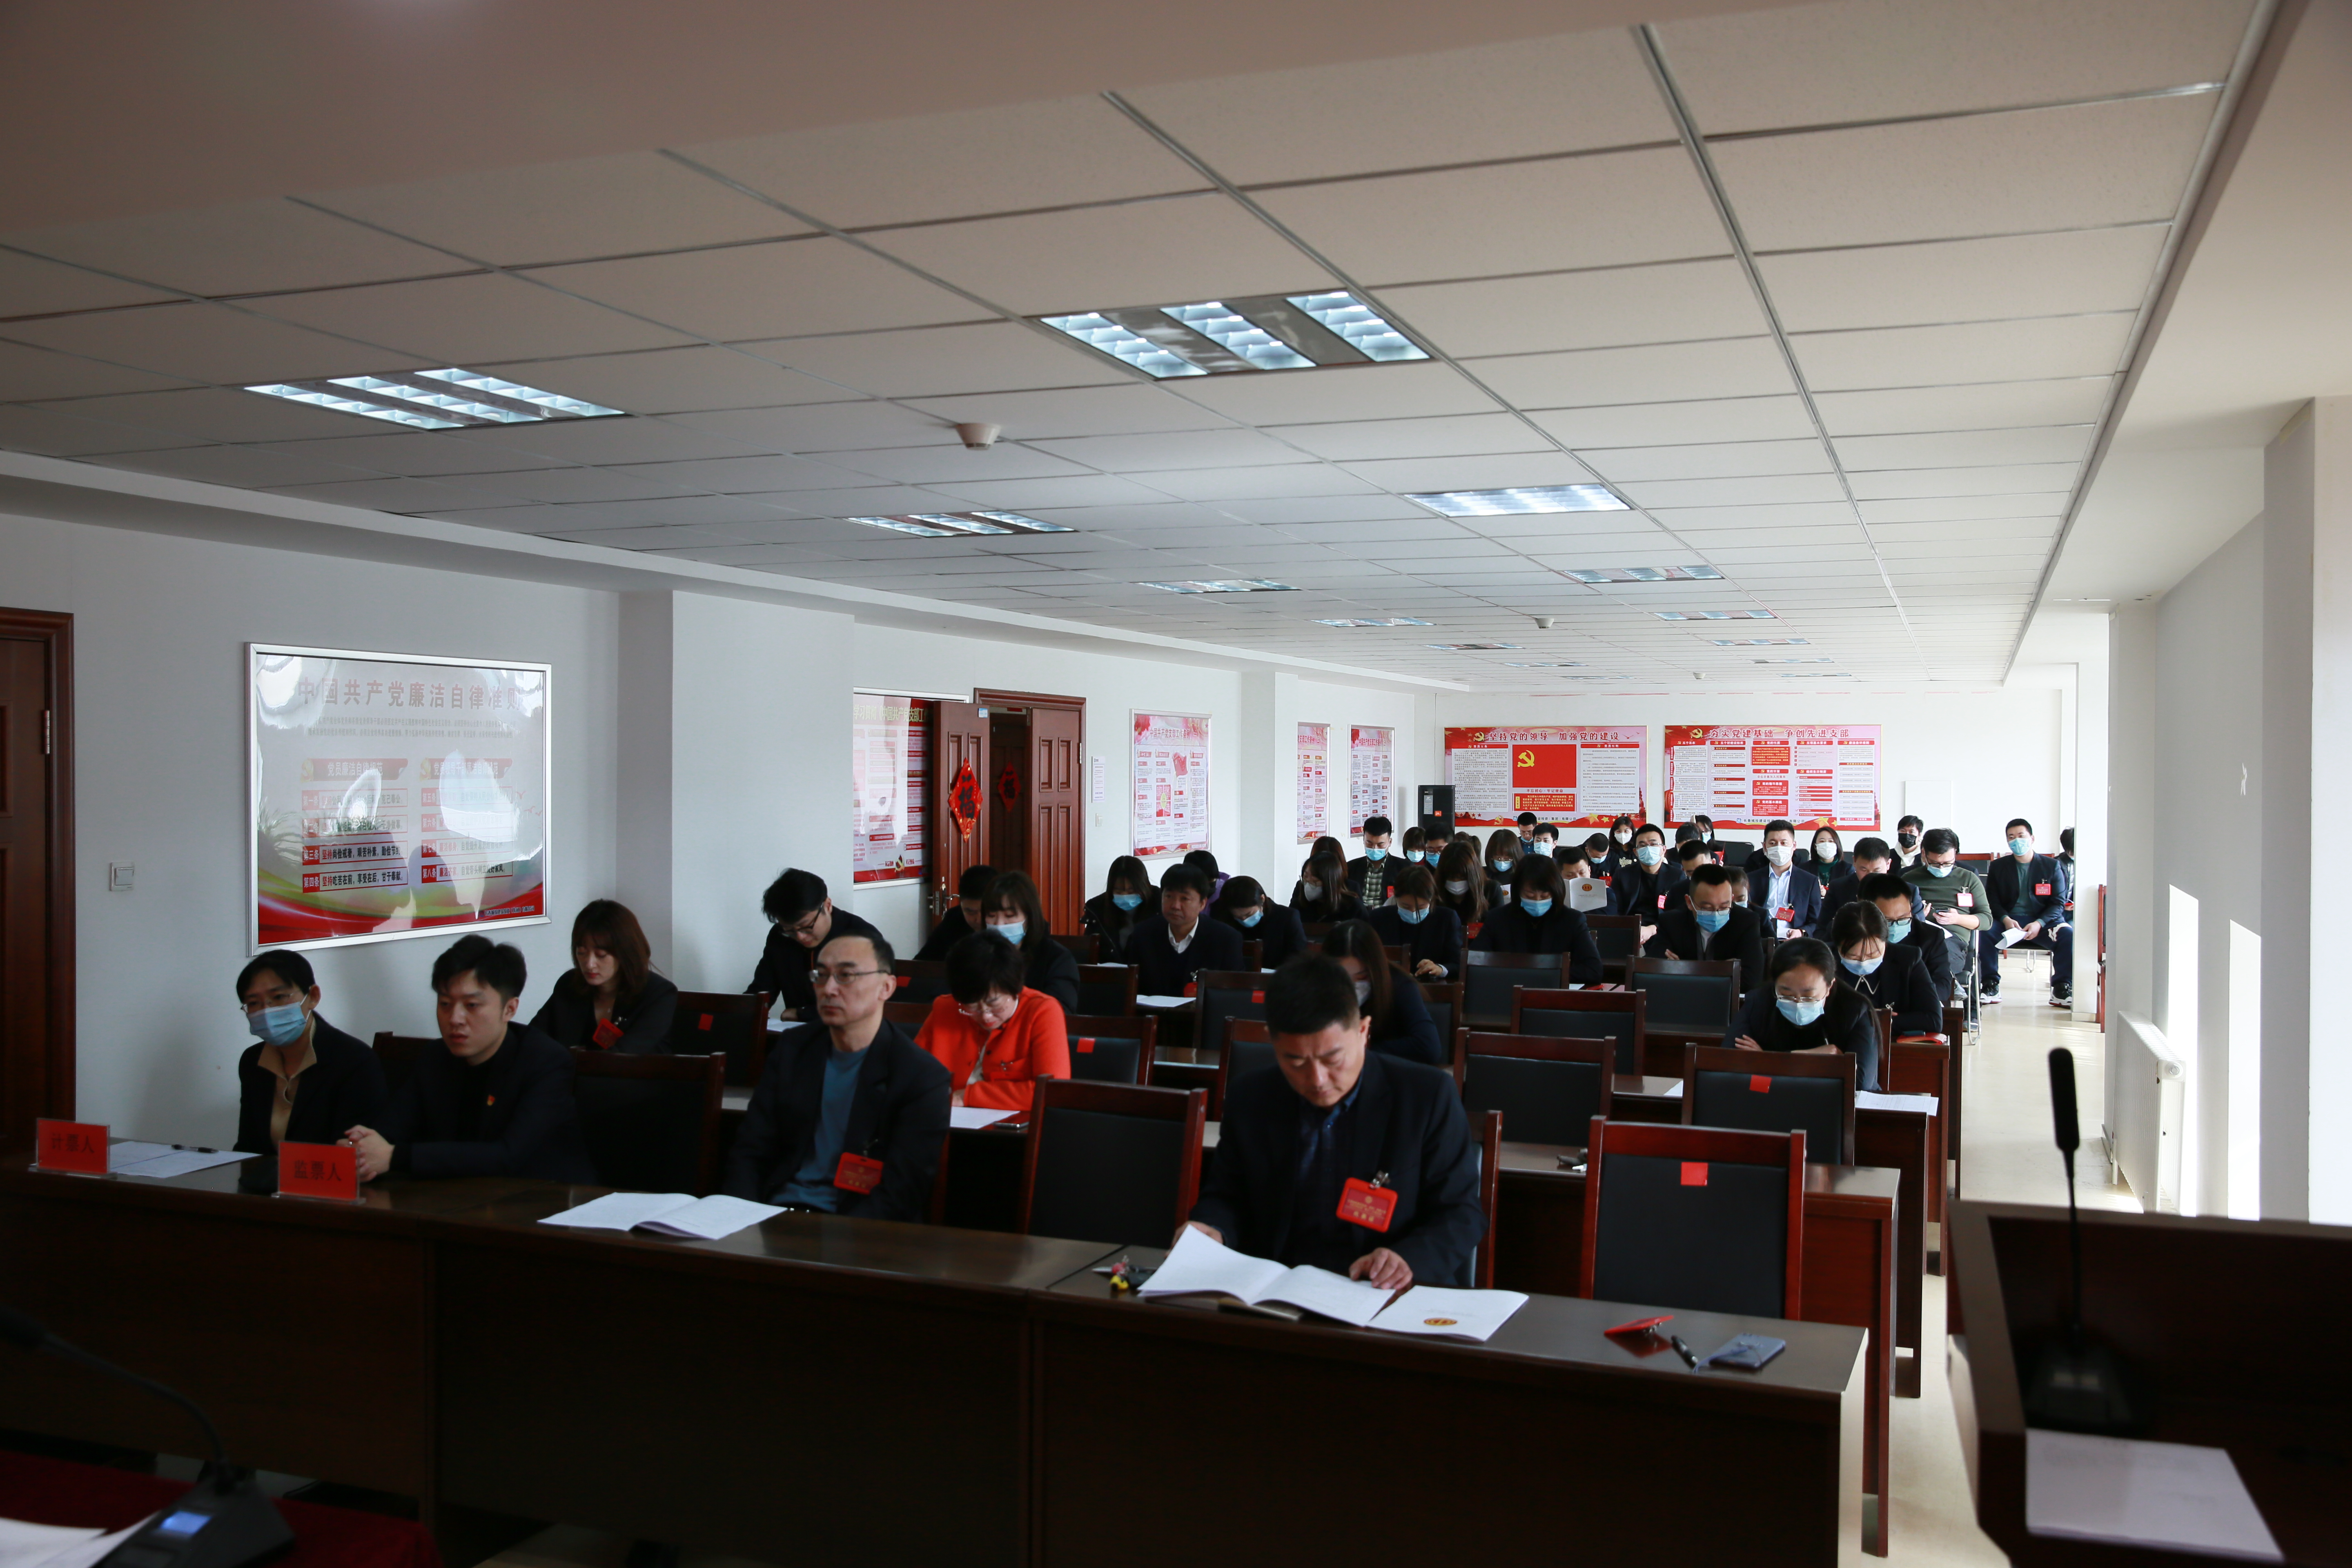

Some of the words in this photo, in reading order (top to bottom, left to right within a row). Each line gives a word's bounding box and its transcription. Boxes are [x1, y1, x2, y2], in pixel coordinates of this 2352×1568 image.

[298, 676, 521, 710] 中国共产党廉洁自律准则
[1489, 732, 1548, 741] 坚持党的领导
[1559, 732, 1619, 740] 加强党的建设
[1710, 729, 1773, 738] 夯实党建基础
[1784, 729, 1849, 738] 争创先进支部
[328, 762, 383, 776] 党员廉洁自律规范
[422, 793, 436, 803] 第五条
[422, 818, 437, 828] 第六条
[422, 843, 437, 853] 第七条
[304, 850, 319, 860] 第三条
[423, 869, 437, 878] 第八条
[304, 877, 319, 888] 第四条
[322, 870, 403, 886] 坚持吃苦在前，享受在后，甘于奉献。
[51, 1133, 95, 1153] 计票人
[294, 1160, 341, 1181] 监票人
